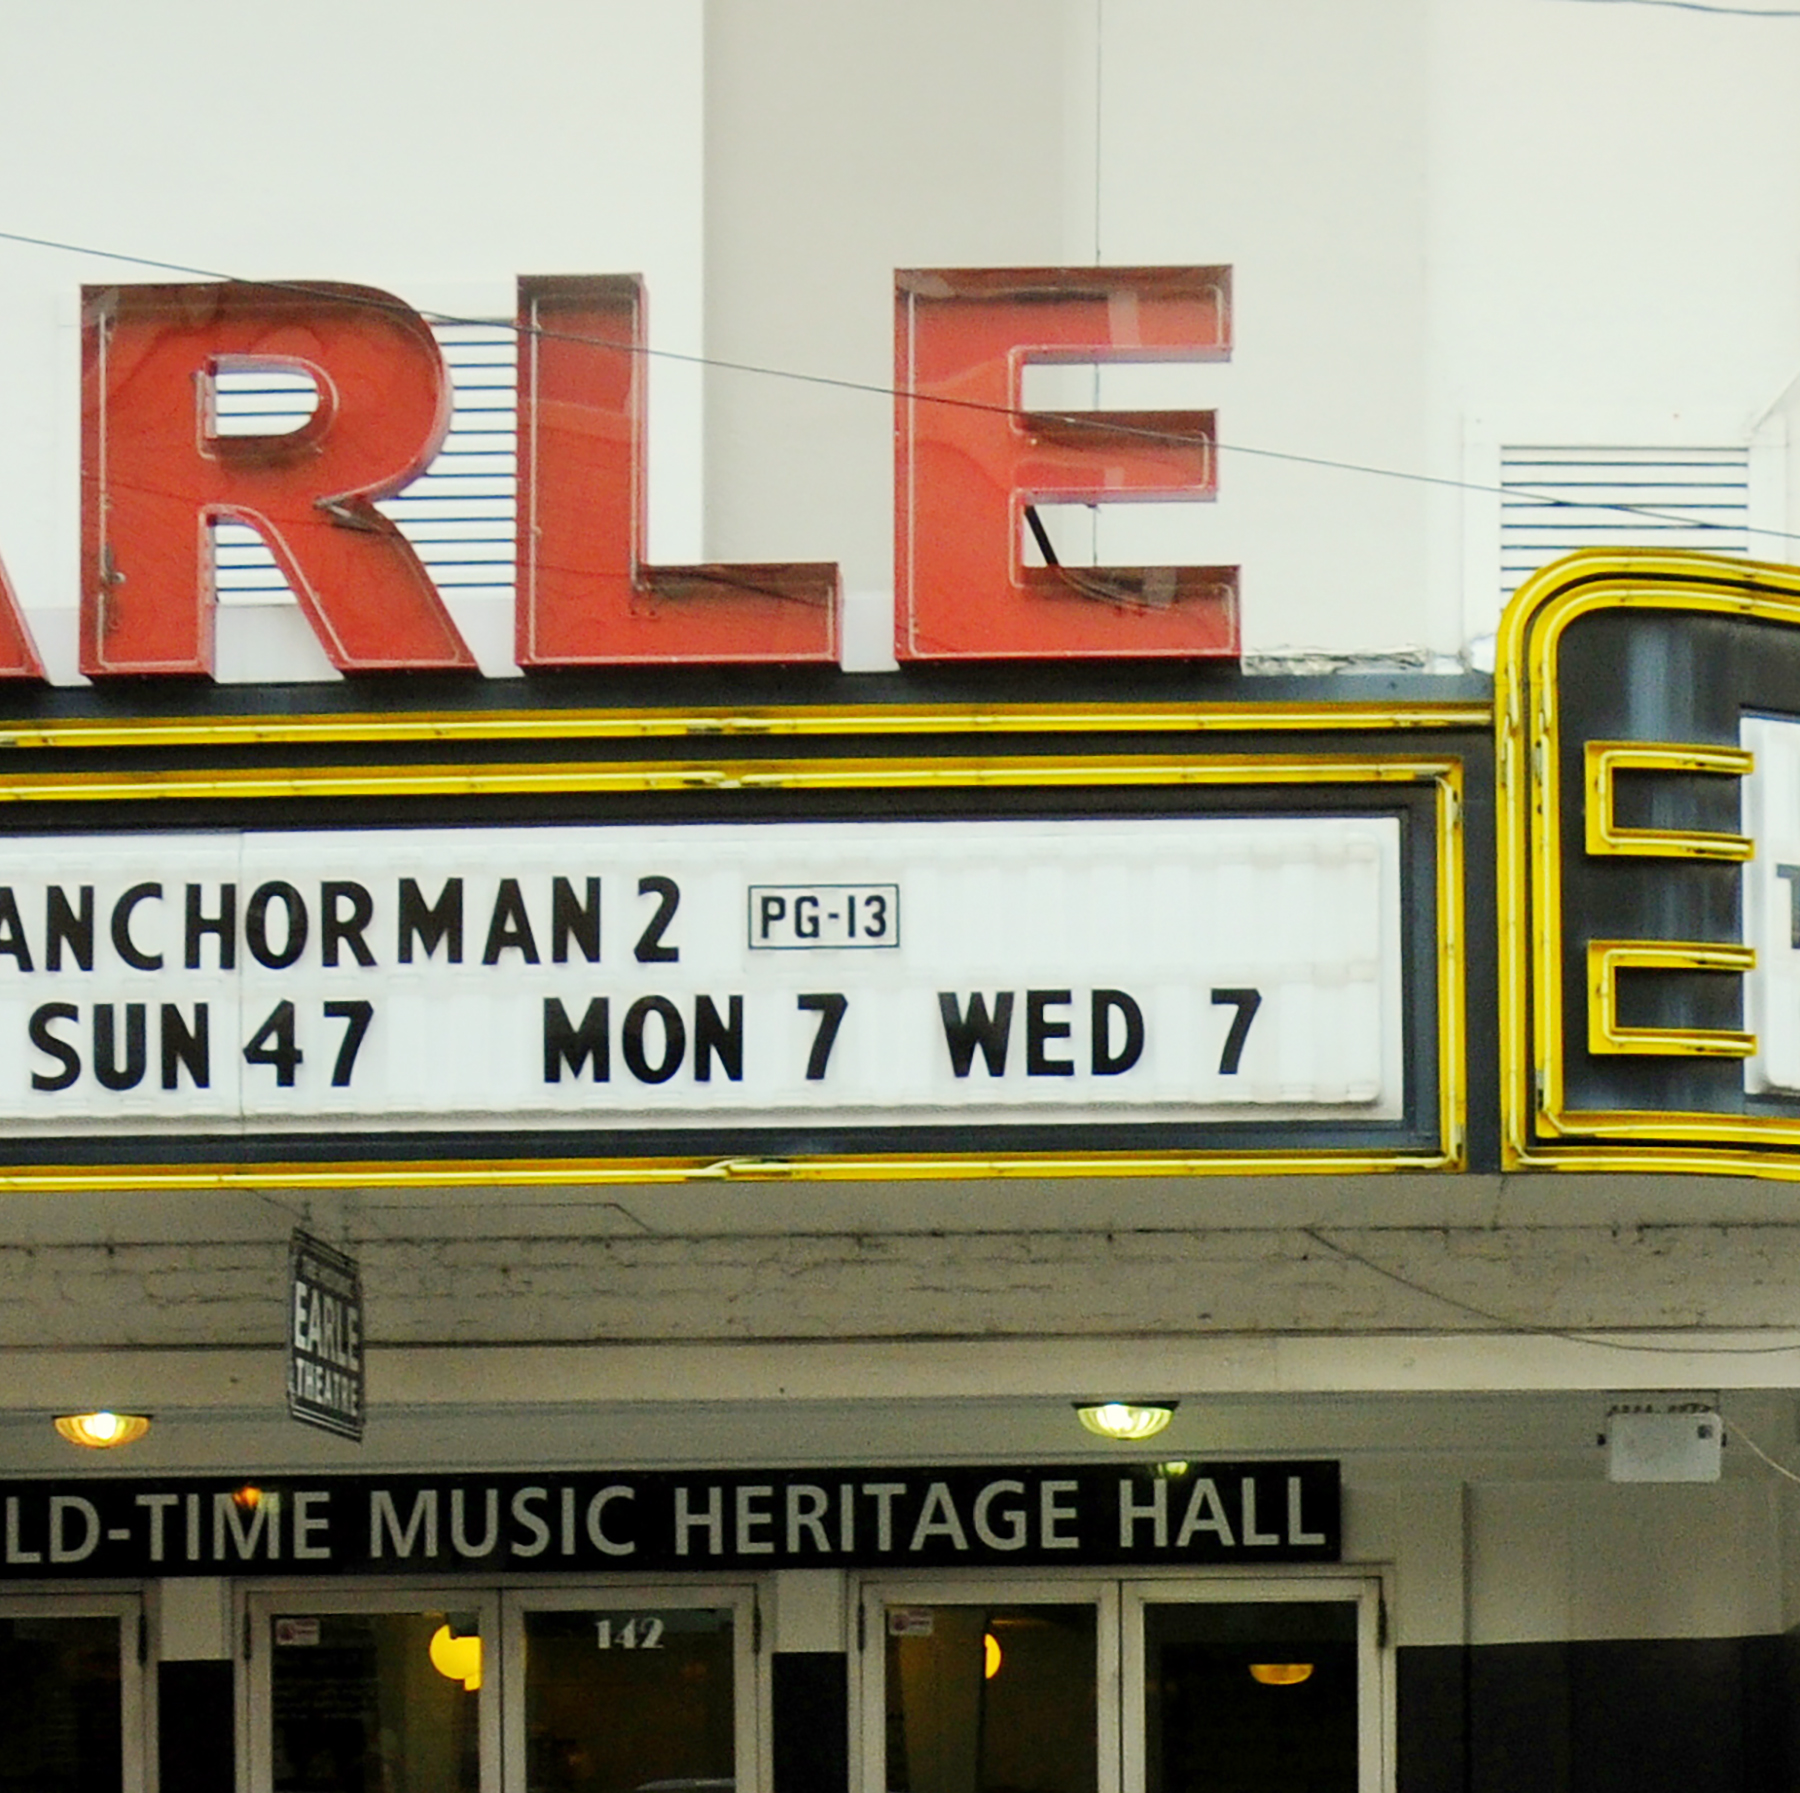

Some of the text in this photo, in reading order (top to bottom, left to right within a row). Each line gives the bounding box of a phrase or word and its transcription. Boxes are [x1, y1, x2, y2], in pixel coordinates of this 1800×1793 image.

[634, 876, 682, 964] 2
[760, 893, 889, 940] PG-13
[29, 1000, 210, 1092] SUN
[543, 993, 743, 1085] MON
[797, 992, 849, 1081] 7
[937, 988, 1144, 1078] WED
[1211, 988, 1263, 1076] 7
[295, 1281, 359, 1373] EARLE
[369, 1486, 635, 1559] MUSIC
[674, 1480, 1080, 1556] HERITAGE
[1118, 1475, 1326, 1547] HALL
[594, 1617, 664, 1650] 142
